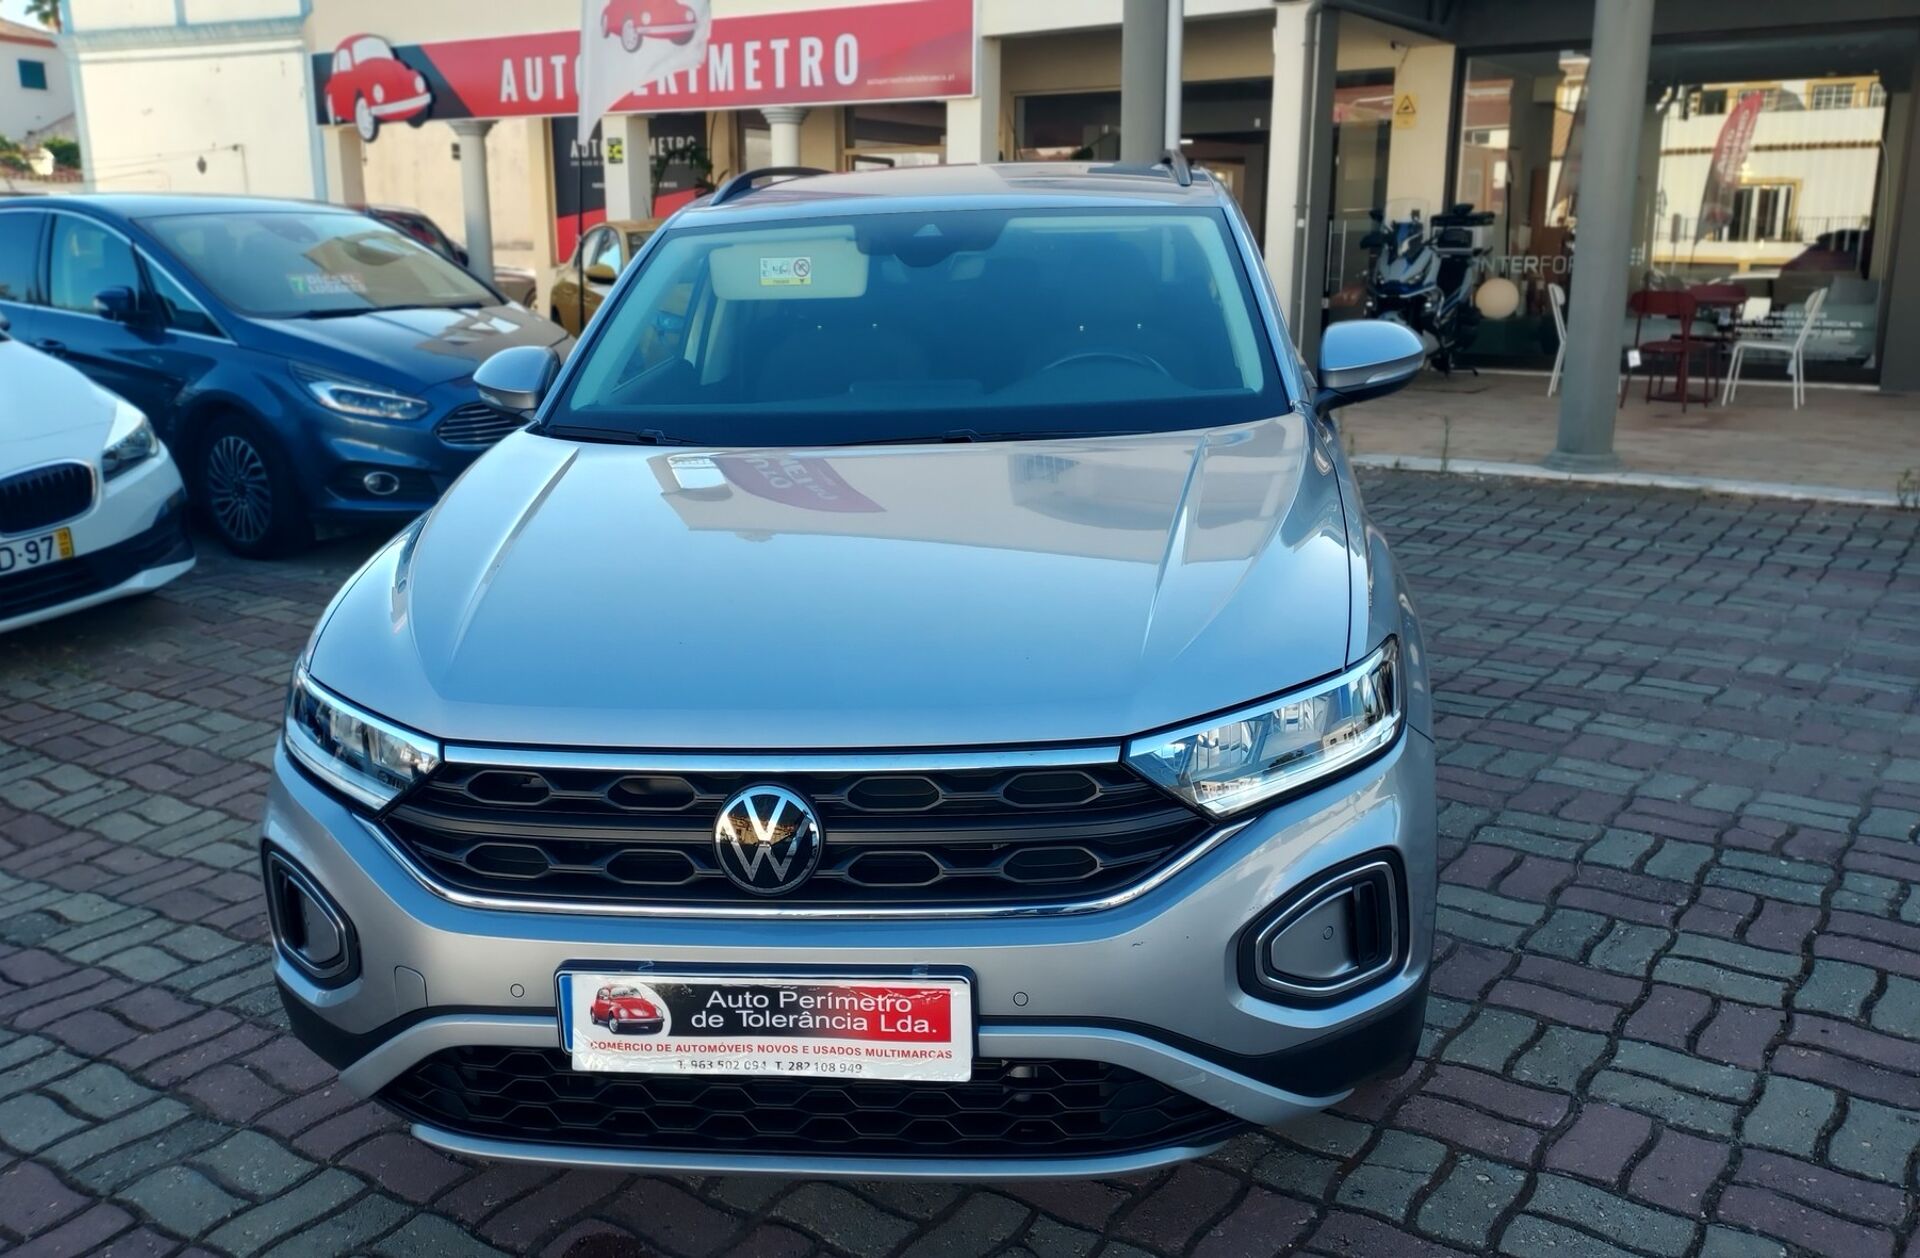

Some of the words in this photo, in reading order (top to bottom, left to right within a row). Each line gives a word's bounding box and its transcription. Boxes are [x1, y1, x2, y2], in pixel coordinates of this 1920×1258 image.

[705, 990, 769, 1009] Auto
[779, 991, 912, 1013] Perímetro
[691, 1010, 725, 1028] de
[735, 1010, 868, 1031] Tolerância
[880, 1014, 937, 1033] Lda.
[590, 1040, 653, 1052] COMÉRCIO
[655, 1043, 672, 1053] DE
[675, 1041, 753, 1054] AUTOMÓVEIS
[757, 1044, 799, 1055] NOVOS
[802, 1045, 809, 1055] E
[812, 1045, 862, 1056] USADOS
[865, 1048, 953, 1060] MULTIMARCAS
[690, 1059, 714, 1070] 963
[717, 1060, 740, 1071] 502
[774, 1061, 784, 1071] T.
[814, 1062, 836, 1073] 108
[839, 1063, 863, 1074] 949
